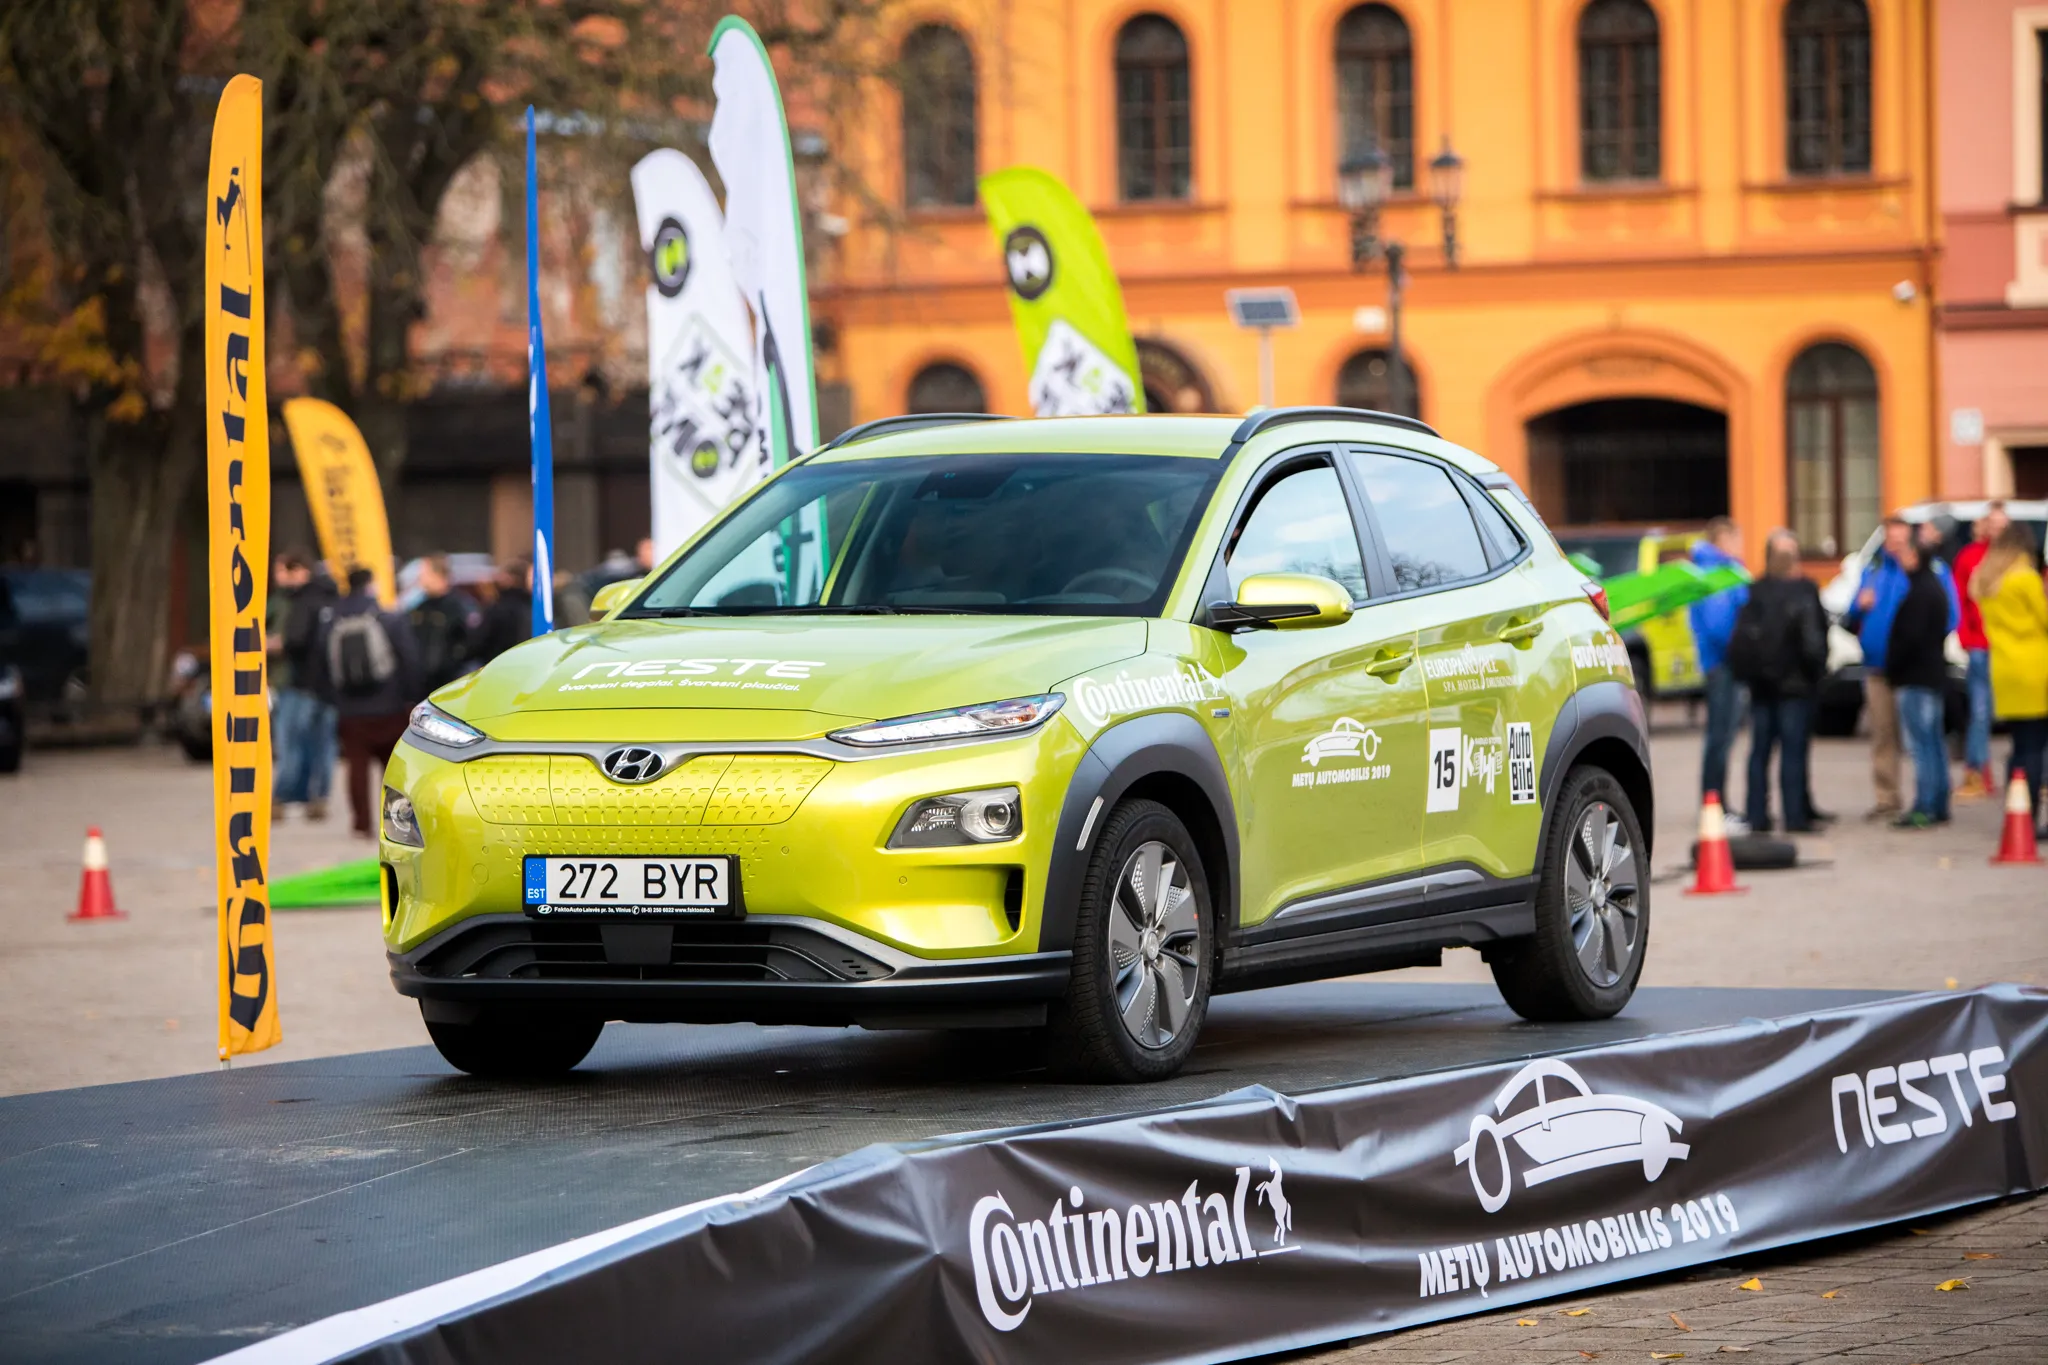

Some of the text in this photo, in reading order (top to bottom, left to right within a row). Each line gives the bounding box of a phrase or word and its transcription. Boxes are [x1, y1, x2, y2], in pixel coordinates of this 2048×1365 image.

[572, 658, 826, 680] NESTE
[1457, 678, 1481, 692] HOTEL
[1072, 662, 1207, 728] Continental
[1509, 726, 1531, 759] Auto
[1292, 764, 1391, 789] METŲ AUTOMOBILIS 2019
[1434, 748, 1456, 790] 15
[1512, 761, 1534, 791] Bild
[527, 888, 546, 899] EST
[559, 863, 719, 900] 272 BYR
[1831, 1045, 2017, 1154] NESTE
[969, 1166, 1257, 1332] Continental
[1418, 1193, 1740, 1298] METŲ AUTOMOBILIS 2019
